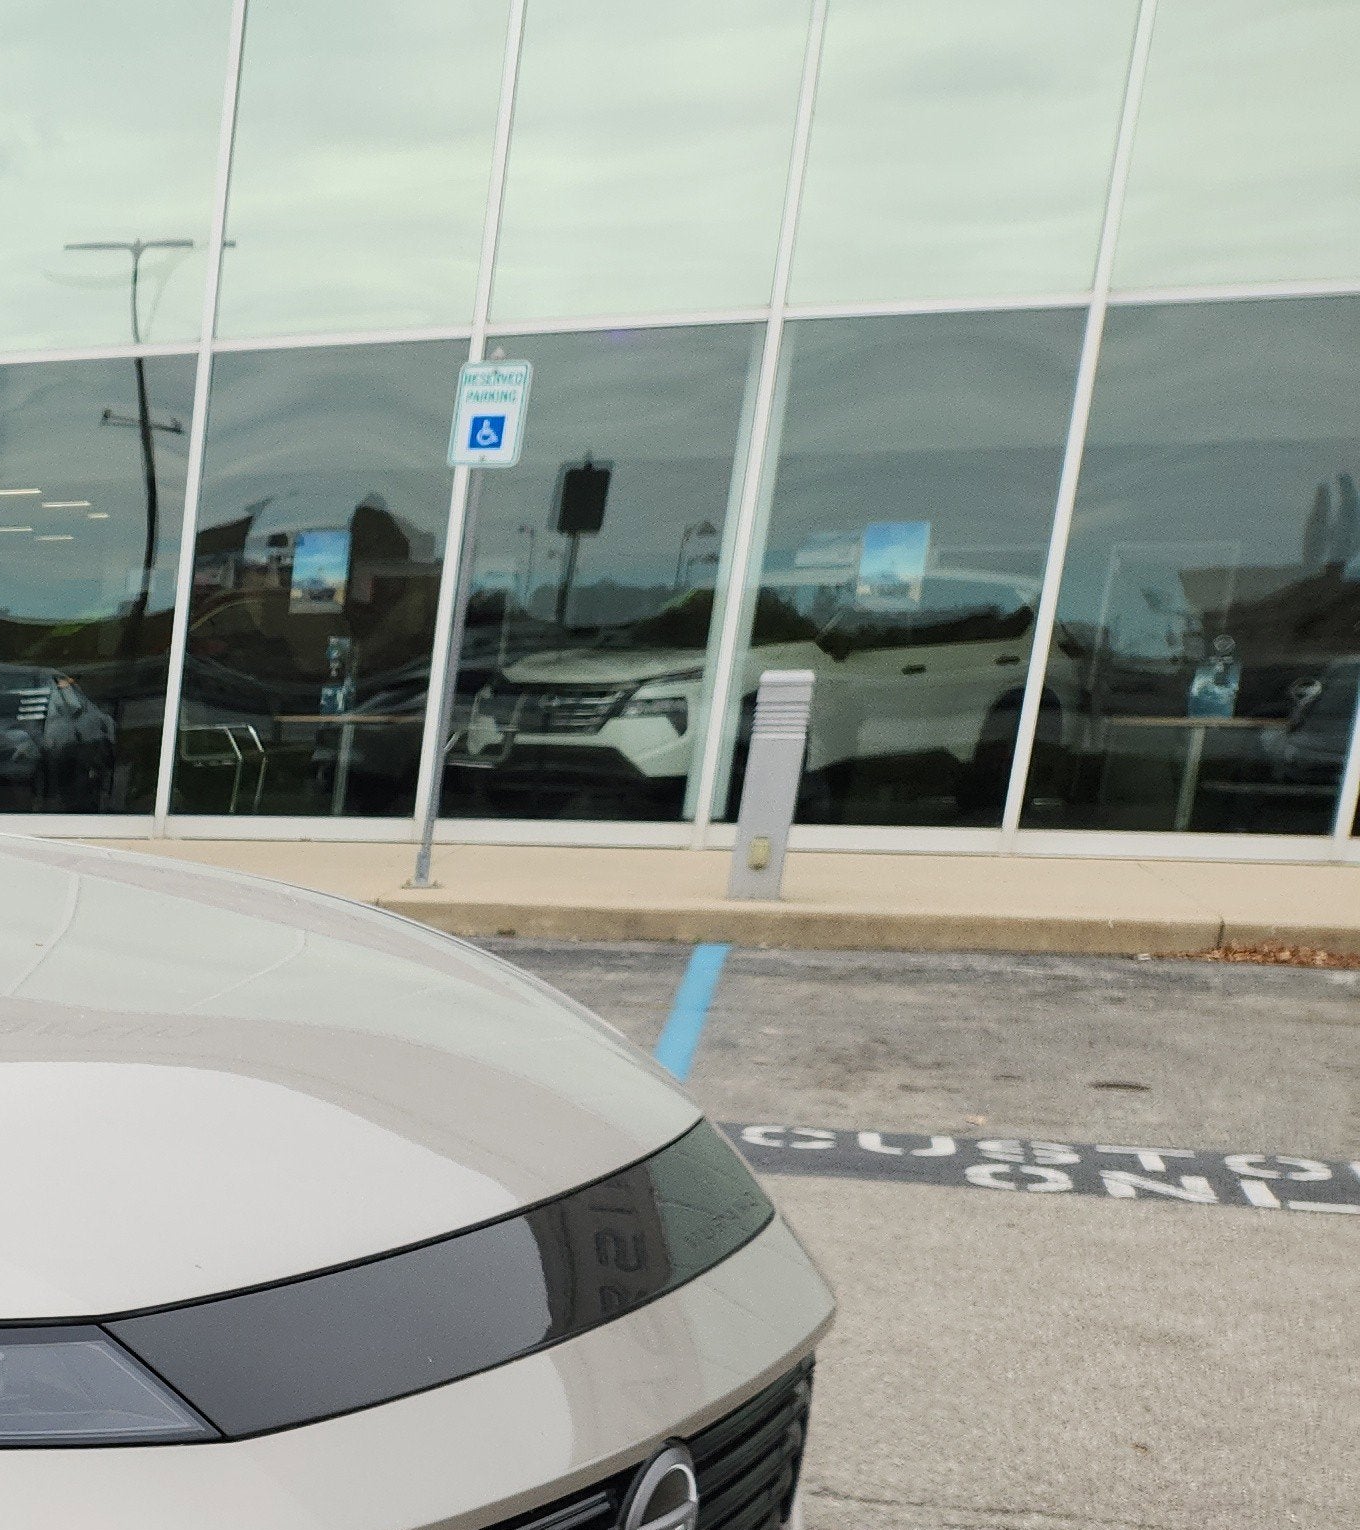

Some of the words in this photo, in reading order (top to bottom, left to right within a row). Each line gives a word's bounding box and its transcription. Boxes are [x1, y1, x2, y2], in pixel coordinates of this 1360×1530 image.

[464, 372, 526, 386] RESERVED
[466, 390, 517, 403] PARKING
[742, 1125, 1360, 1182] CUSTO
